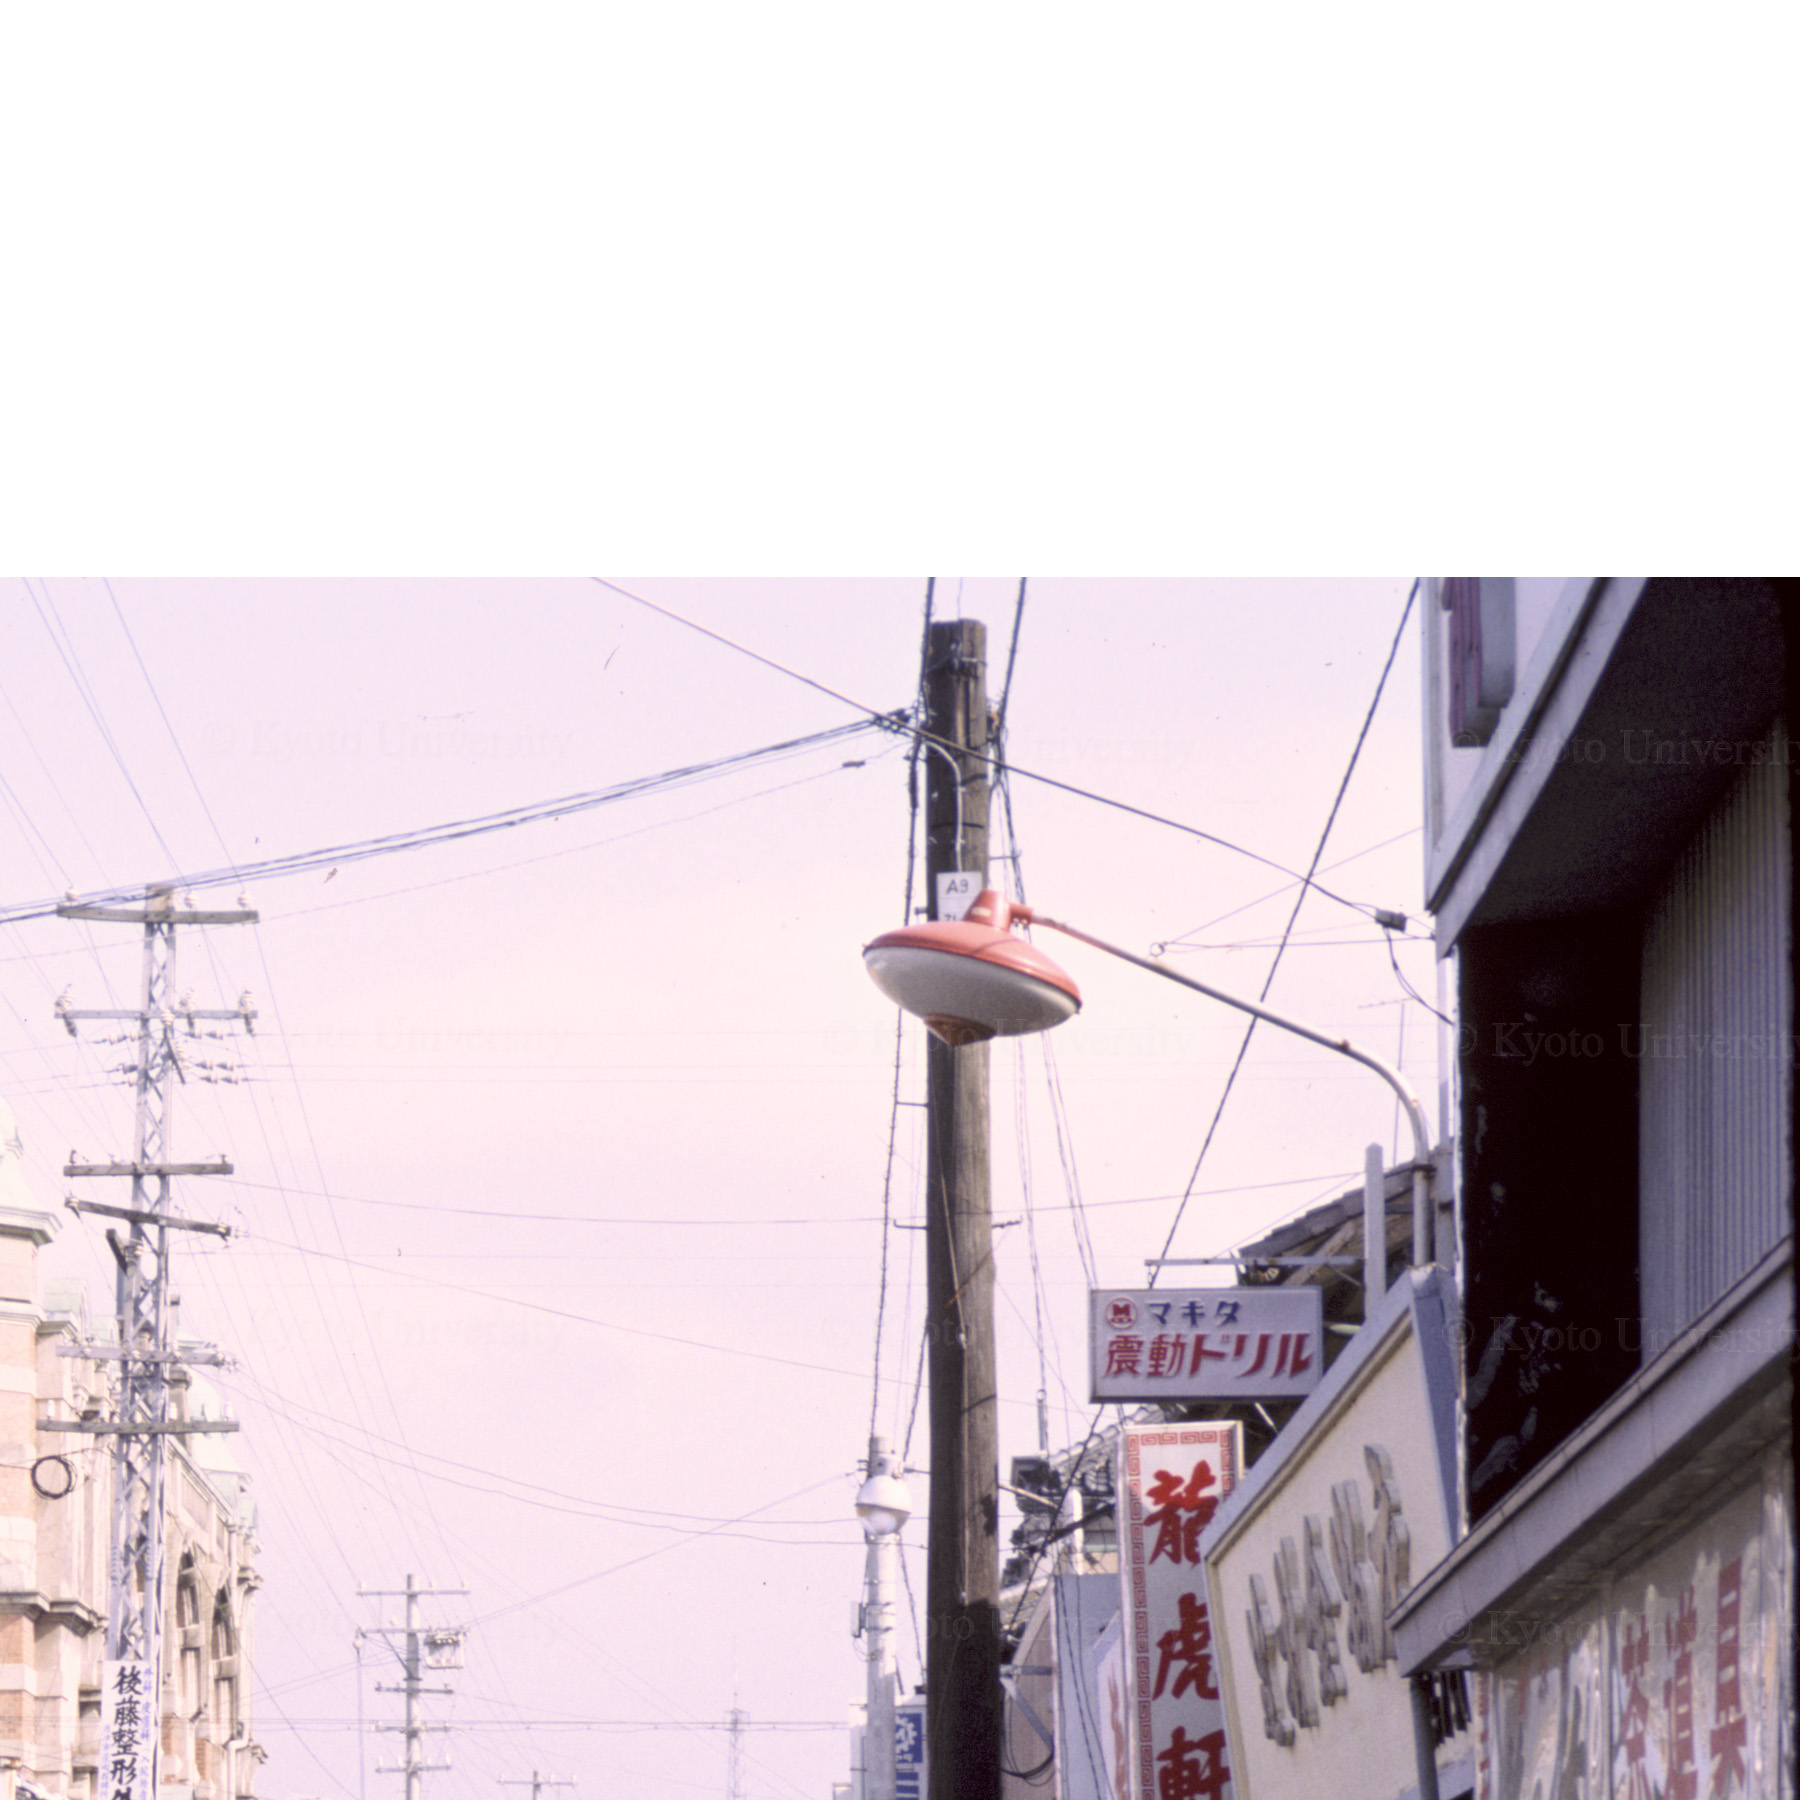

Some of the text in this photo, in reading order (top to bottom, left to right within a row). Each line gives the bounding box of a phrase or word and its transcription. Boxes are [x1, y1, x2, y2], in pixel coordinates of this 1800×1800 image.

[946, 878, 969, 895] A9
[1147, 1300, 1243, 1326] マキタ
[1104, 1331, 1313, 1379] 震動ドリル
